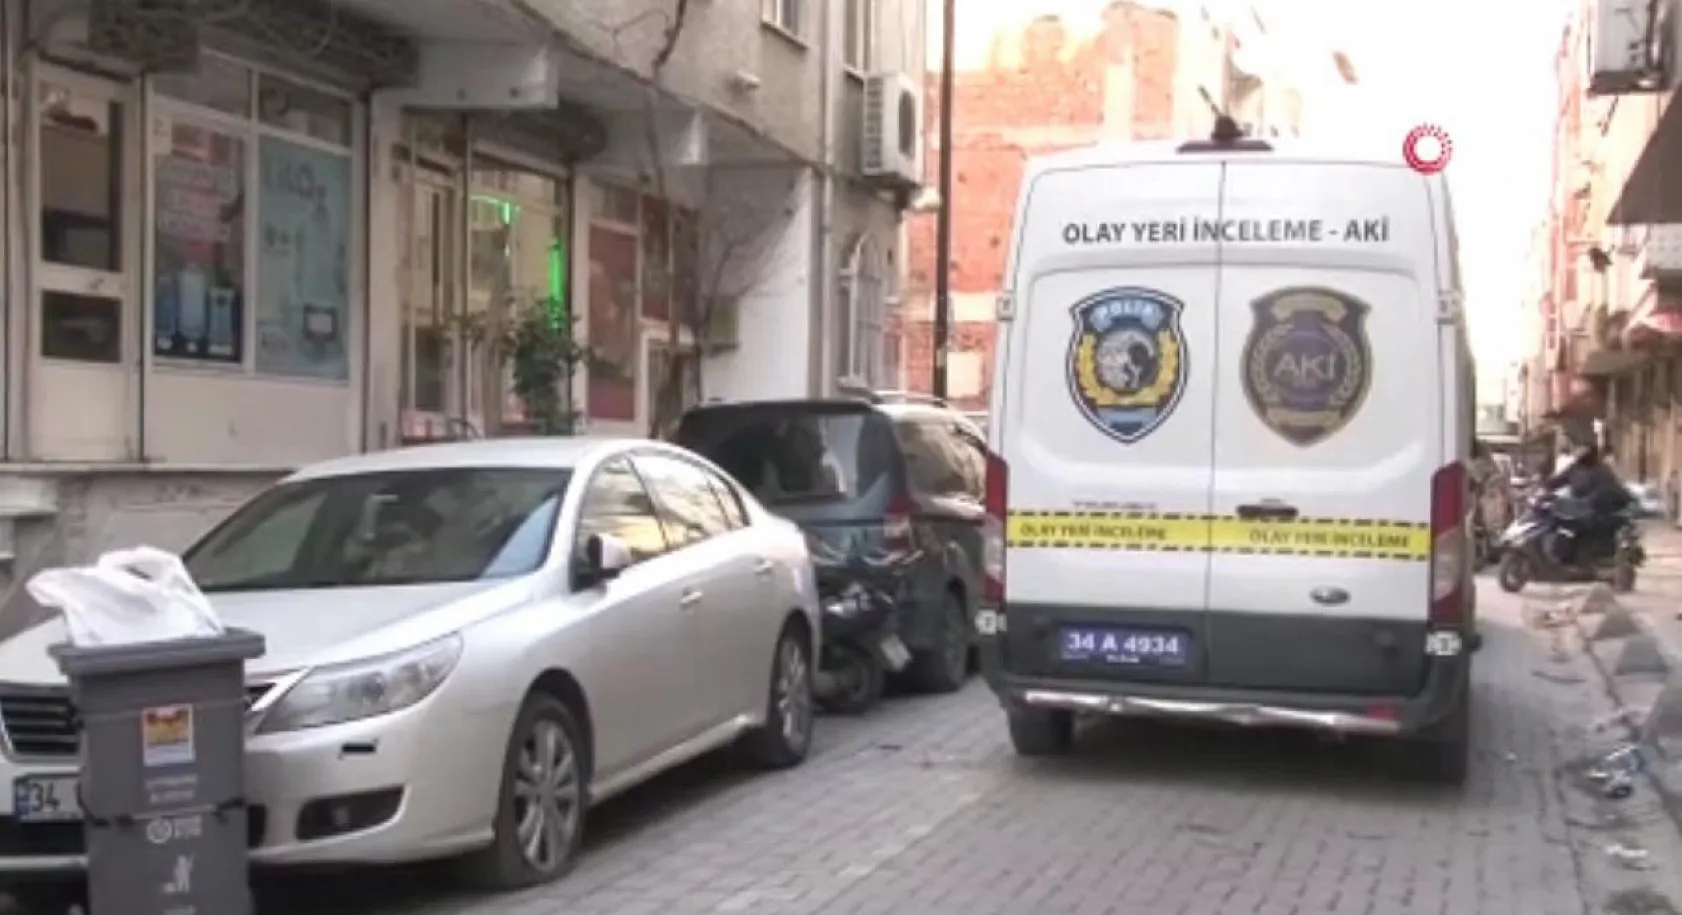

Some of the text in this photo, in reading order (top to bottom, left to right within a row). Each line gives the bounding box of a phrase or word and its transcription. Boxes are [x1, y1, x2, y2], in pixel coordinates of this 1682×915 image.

[1062, 222, 1126, 244] OLAY
[1131, 216, 1186, 242] YERİ
[1193, 215, 1323, 242] İNCELEME
[1343, 215, 1391, 242] AKİ
[1249, 528, 1289, 544] OLAY
[1066, 631, 1180, 655] 34 A 4934
[30, 781, 61, 812] 34
